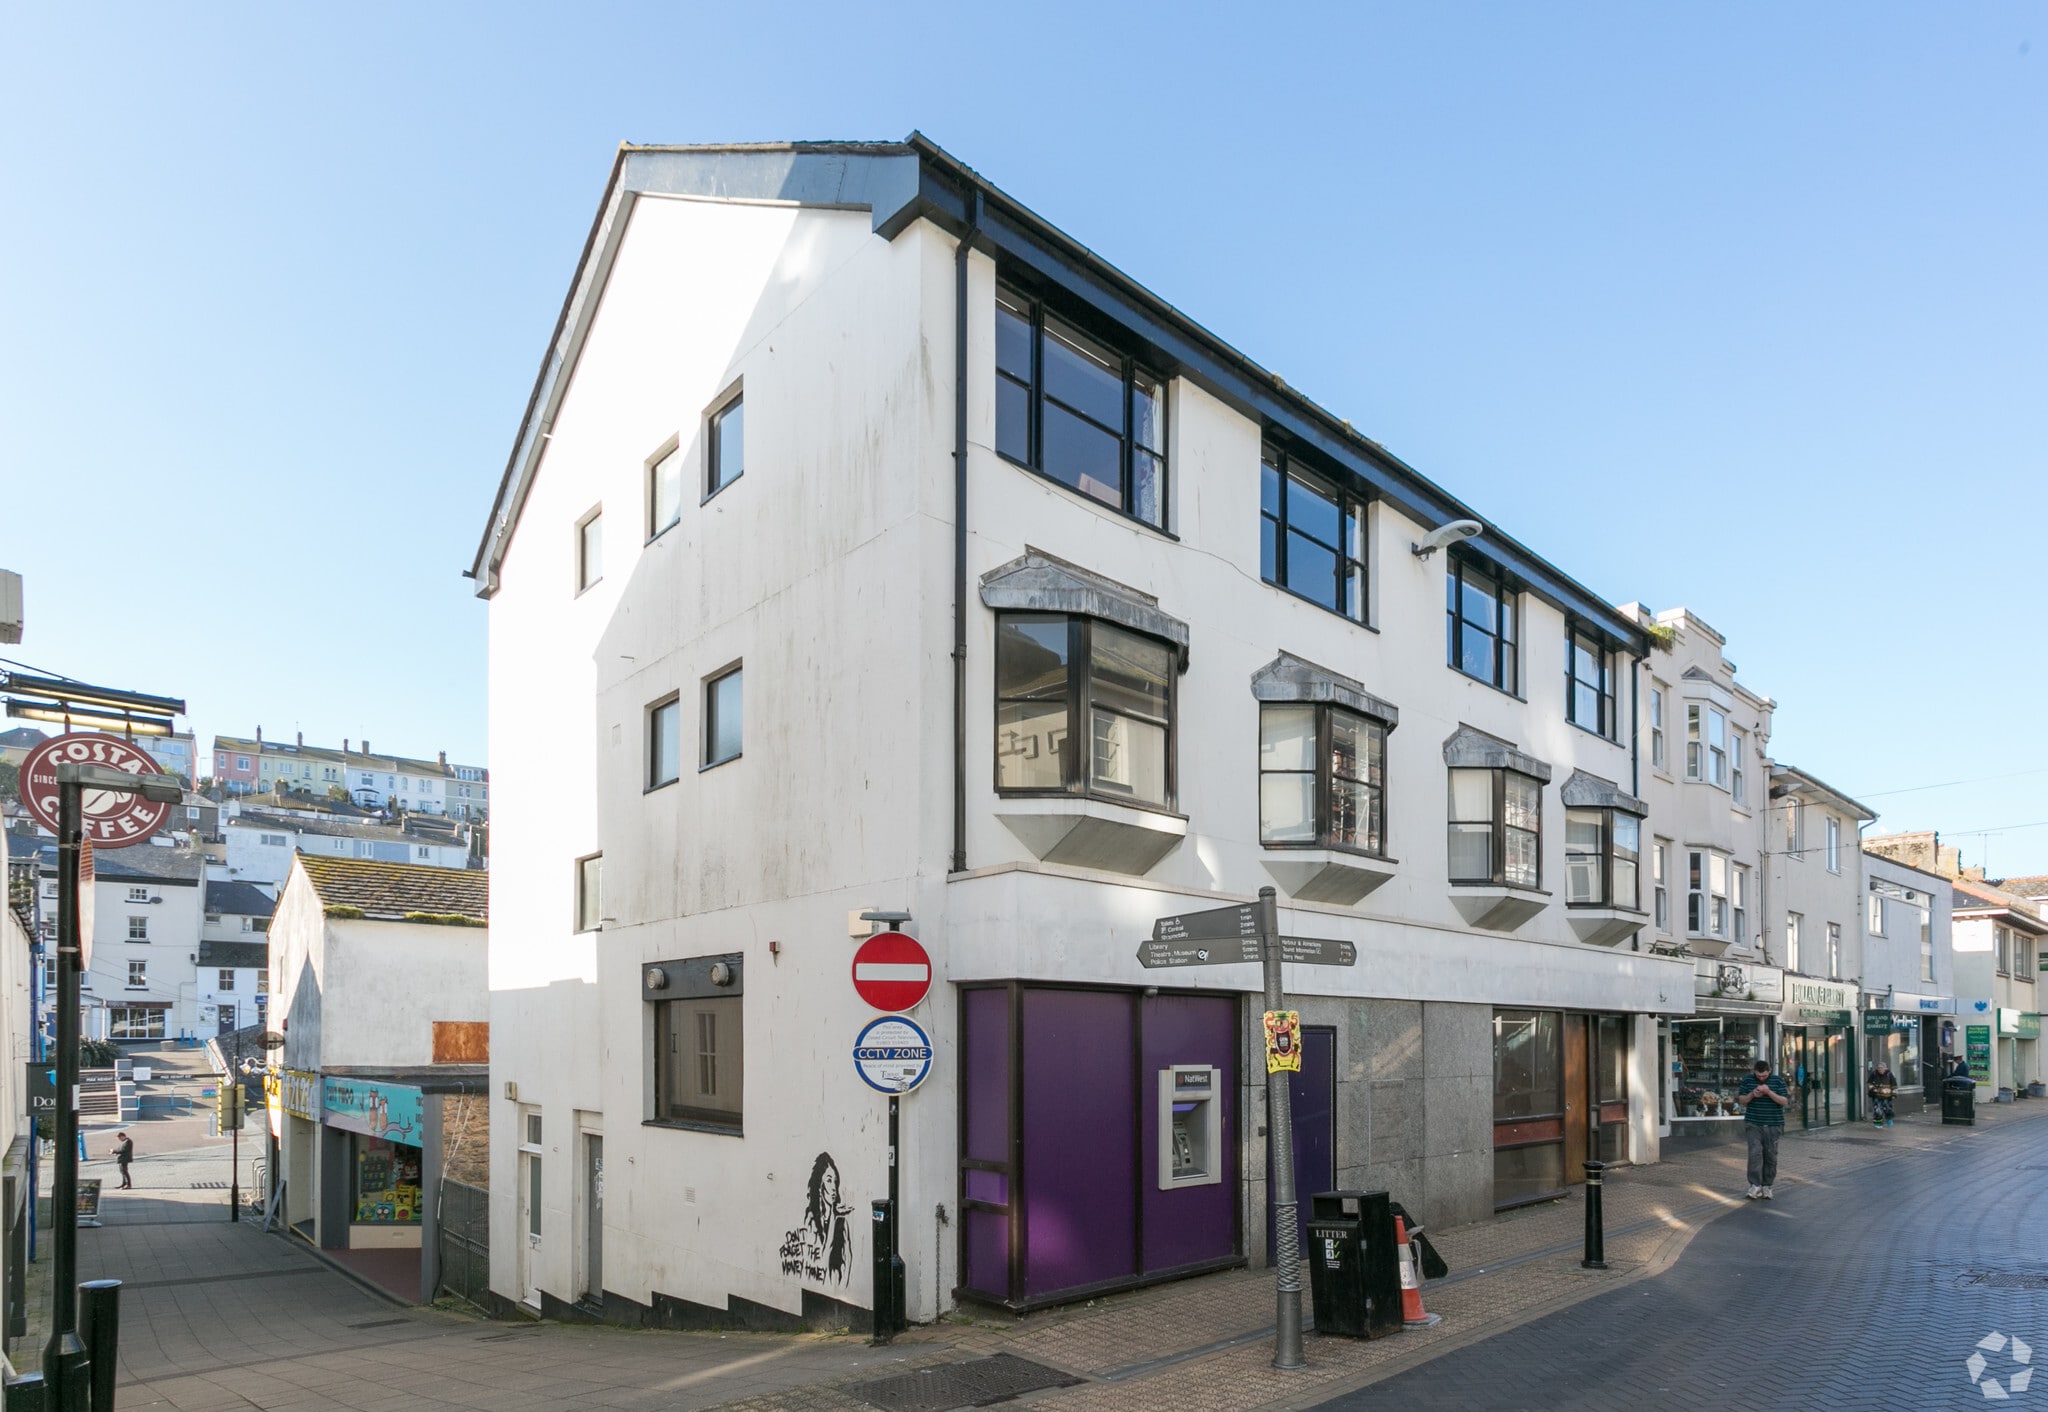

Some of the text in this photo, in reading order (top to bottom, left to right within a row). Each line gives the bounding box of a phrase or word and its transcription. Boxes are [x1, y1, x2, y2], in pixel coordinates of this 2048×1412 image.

[48, 743, 143, 776] COSTA
[1148, 943, 1169, 951] Library
[858, 1048, 927, 1059] CCTV ZONE
[1184, 1074, 1208, 1083] NatWest
[1315, 1229, 1348, 1239] LITTER
[779, 1241, 821, 1262] FORGET THE
[782, 1258, 827, 1285] MONEY HONEY
